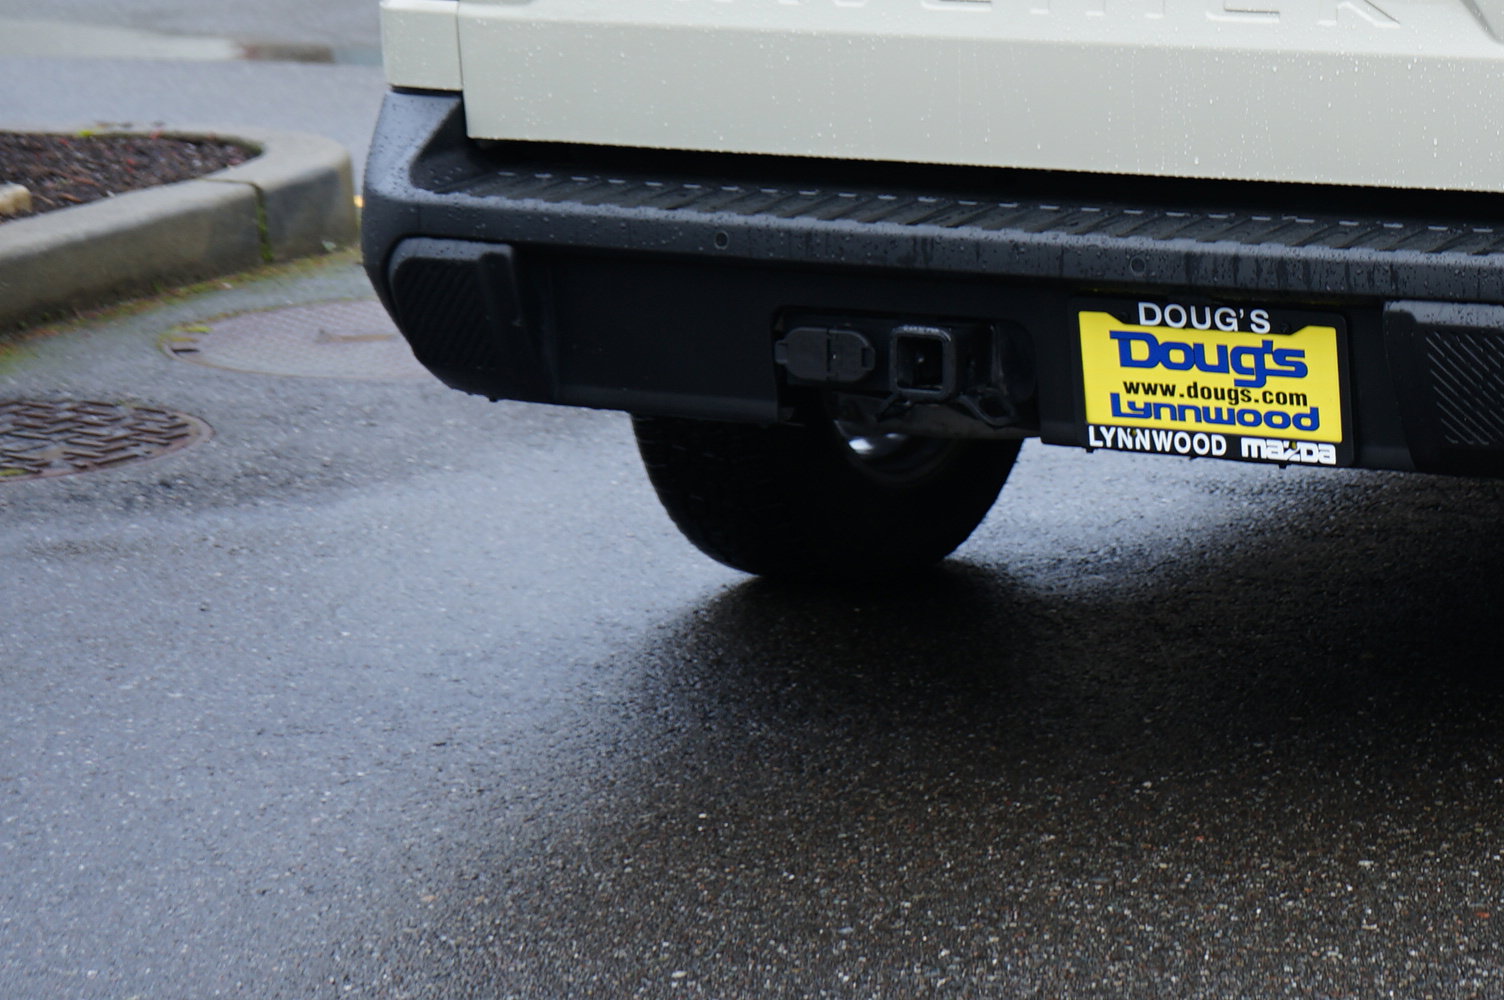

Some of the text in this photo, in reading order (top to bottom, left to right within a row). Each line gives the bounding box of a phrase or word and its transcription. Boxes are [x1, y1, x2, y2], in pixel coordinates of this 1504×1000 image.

[1138, 302, 1270, 334] DOUG'S
[1109, 330, 1309, 388] Doug's
[1123, 381, 1308, 407] www.dougs.com
[1110, 392, 1320, 431] Lynnwood
[1088, 425, 1227, 456] LYNNWOOD
